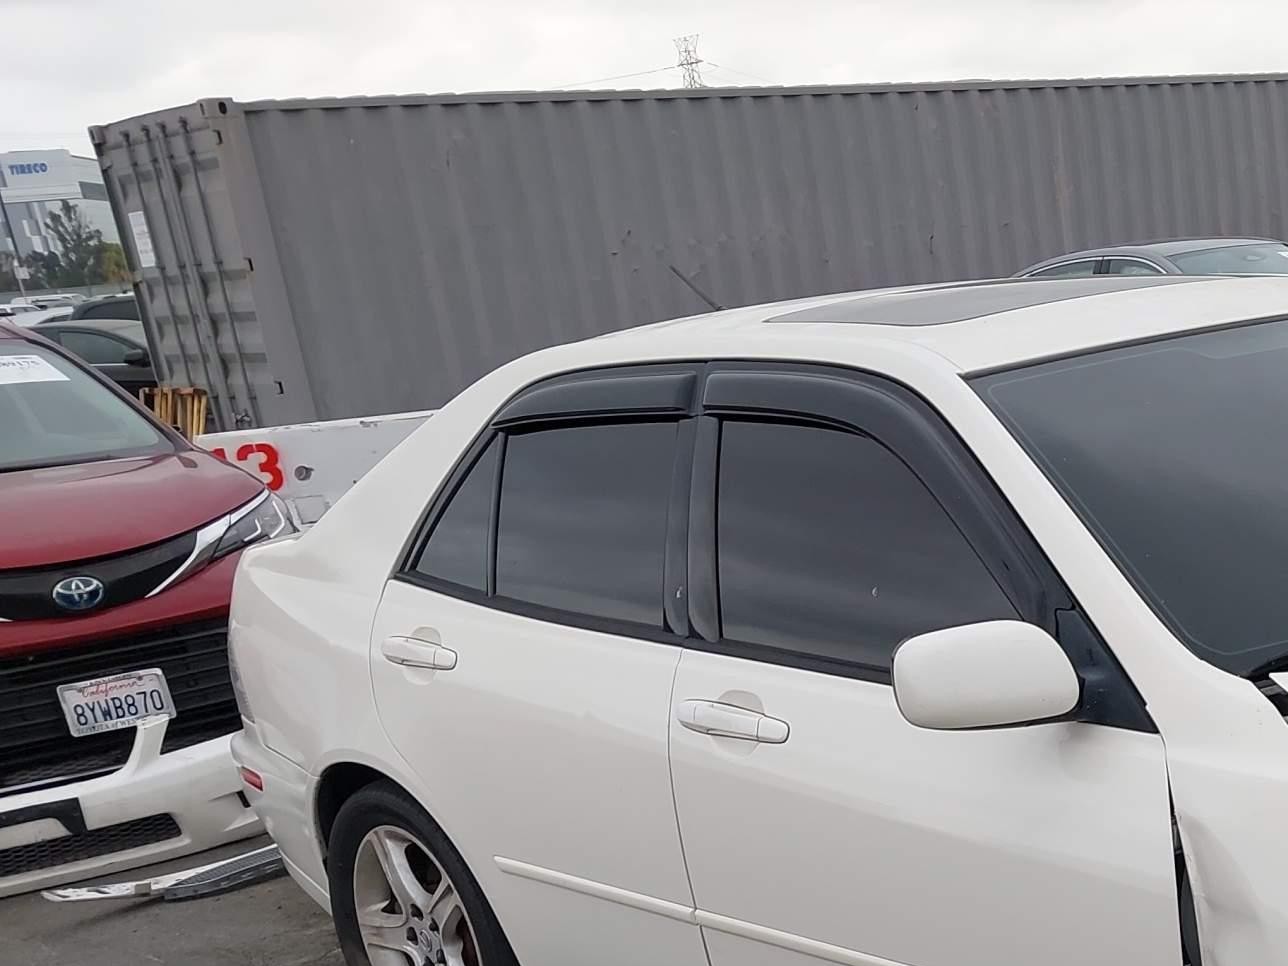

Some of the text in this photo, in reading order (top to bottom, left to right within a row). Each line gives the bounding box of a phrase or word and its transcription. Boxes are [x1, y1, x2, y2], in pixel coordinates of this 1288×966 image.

[8, 162, 48, 176] TIRECO
[81, 680, 141, 698] California
[73, 688, 165, 727] 8YWB870
